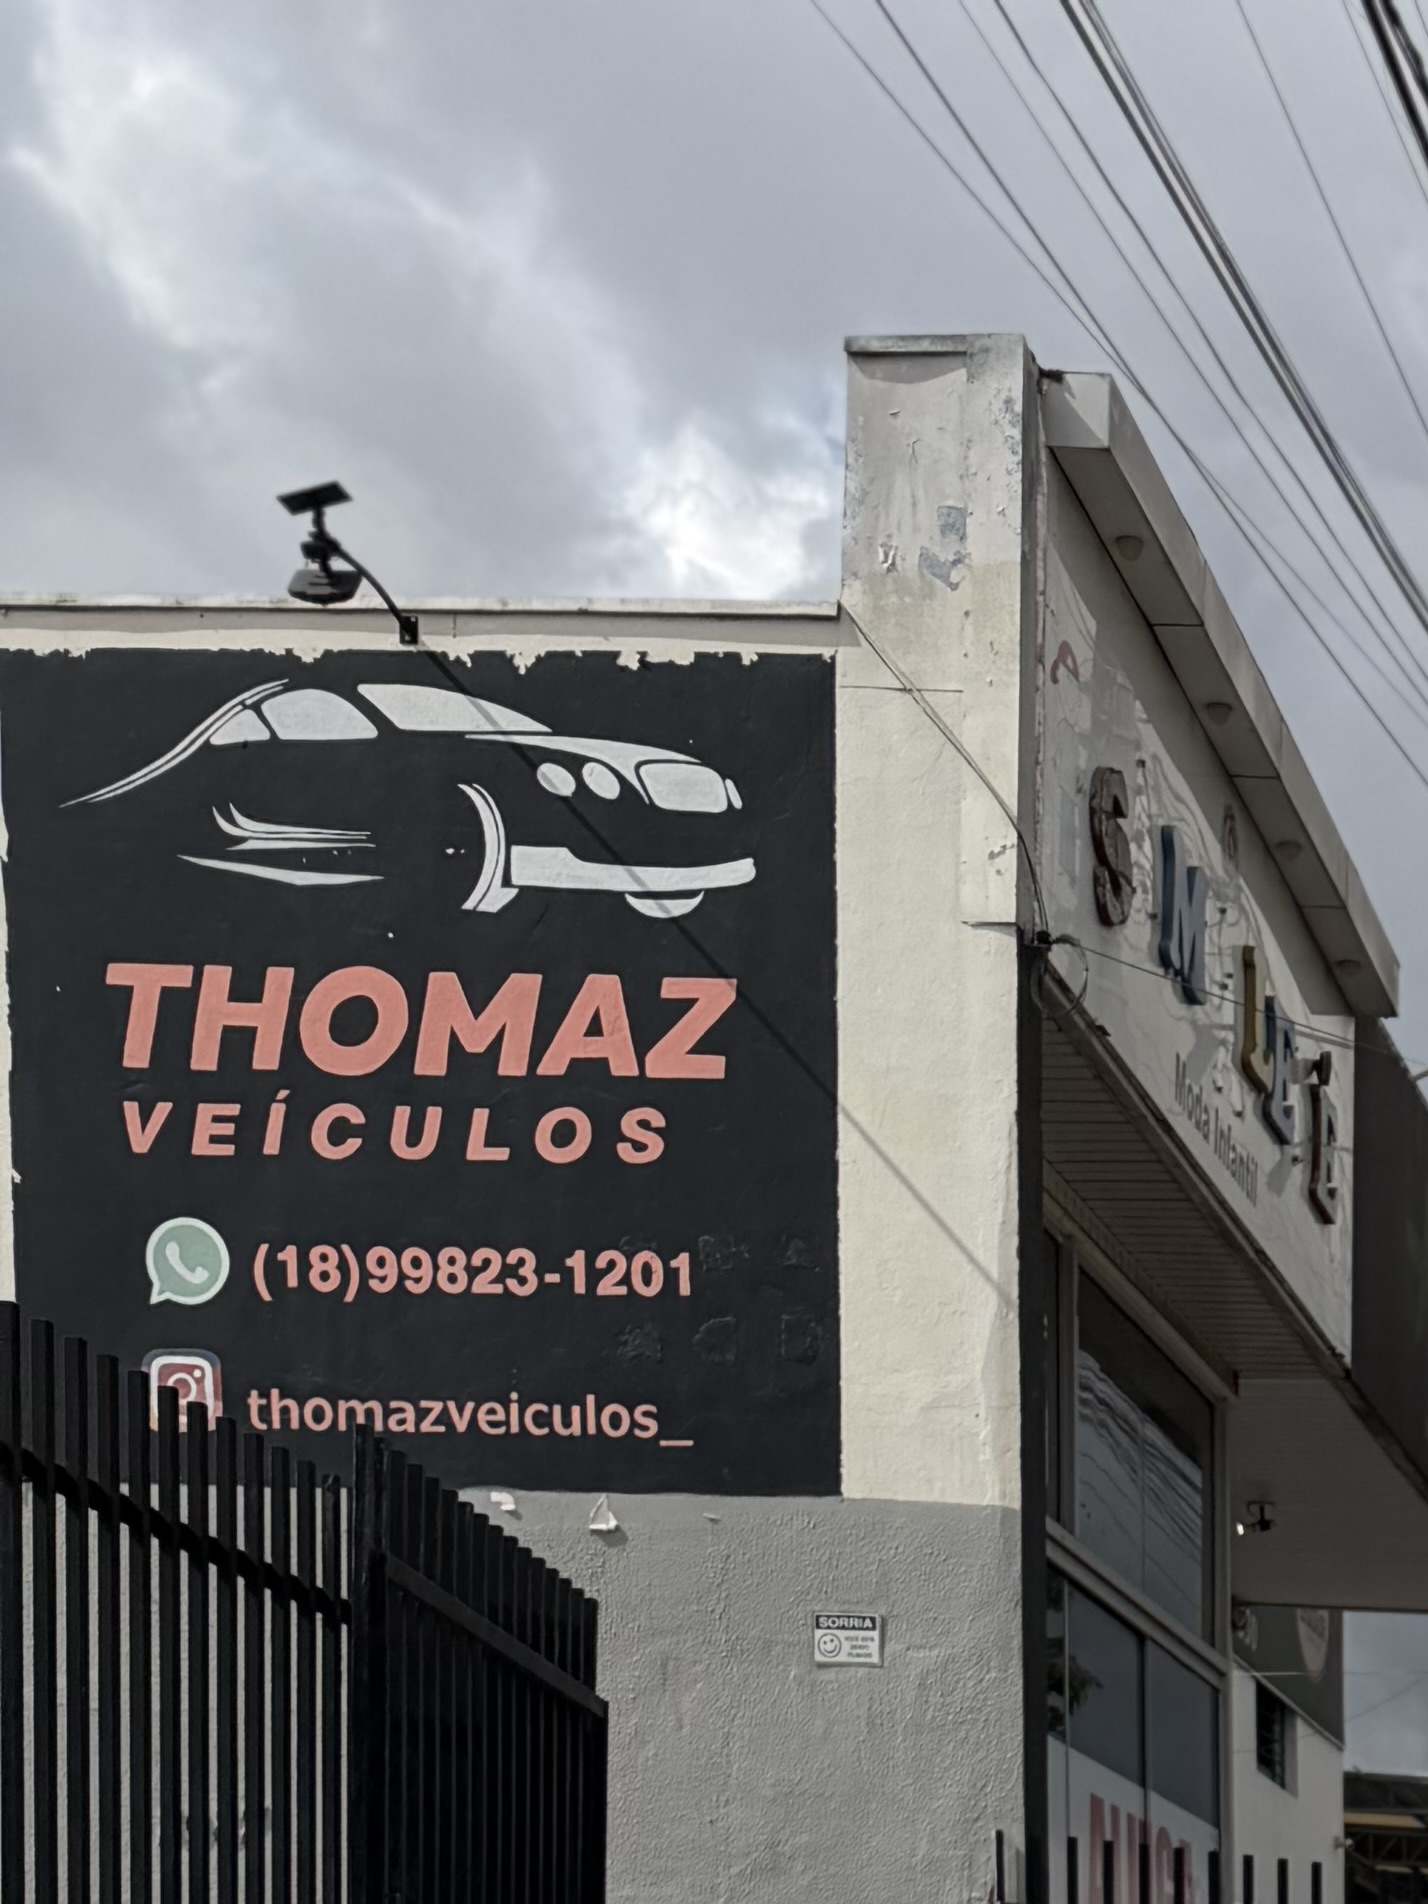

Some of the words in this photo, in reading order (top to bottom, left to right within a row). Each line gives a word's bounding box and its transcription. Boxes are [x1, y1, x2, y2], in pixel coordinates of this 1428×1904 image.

[105, 962, 738, 1080] THOMAZ
[122, 1089, 668, 1165] VEÍCULOS
[1175, 1051, 1210, 1145] Moda
[1213, 1107, 1260, 1208] Infantil
[251, 1242, 694, 1304] (18)99823-1201
[247, 1386, 694, 1447] thomazveiculos_
[818, 1616, 873, 1629] SORRIA
